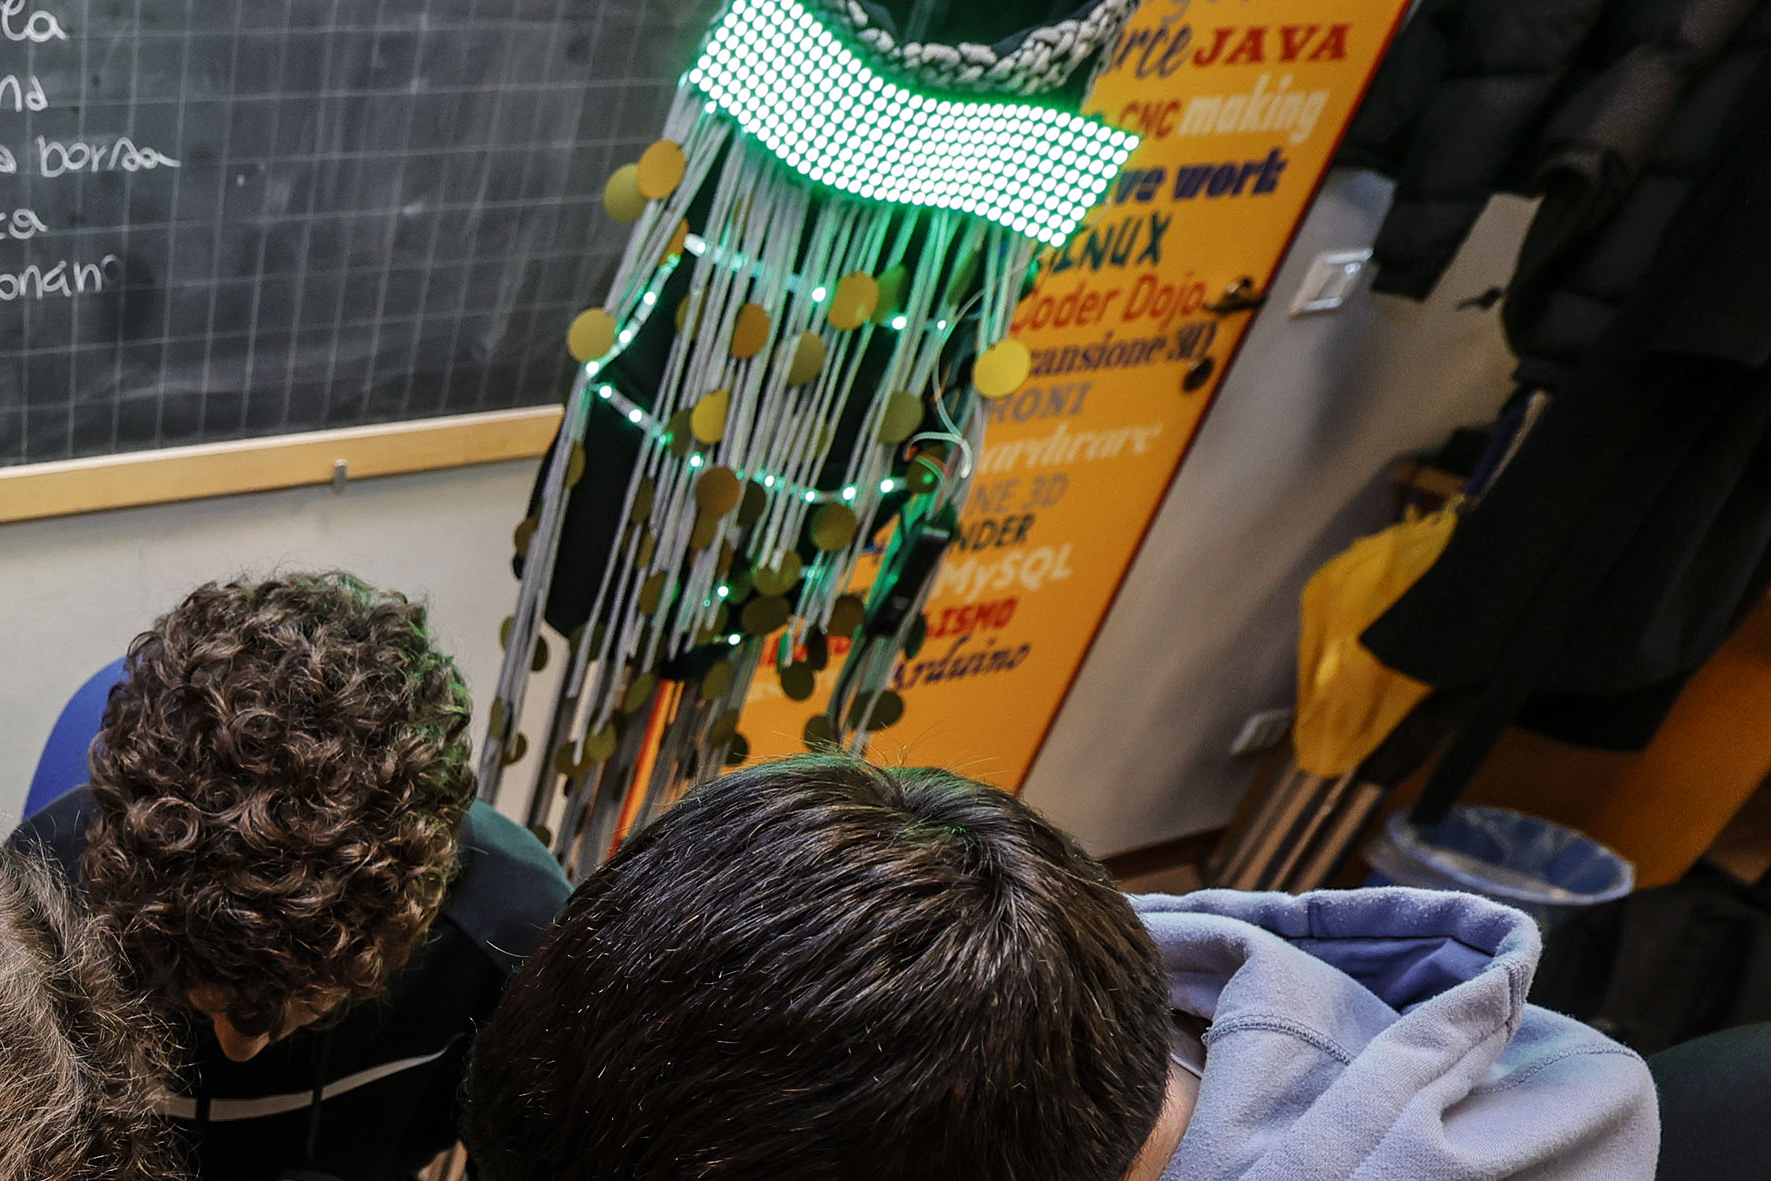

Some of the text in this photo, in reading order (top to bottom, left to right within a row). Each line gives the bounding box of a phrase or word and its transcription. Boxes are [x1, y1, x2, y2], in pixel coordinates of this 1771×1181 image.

[1108, 22, 1354, 80] rce JAVA
[1178, 72, 1330, 146] making
[36, 135, 182, 178] borsa
[1174, 147, 1290, 200] work
[1122, 270, 1208, 332] Dojo
[1031, 330, 1168, 377] ansione
[986, 380, 1094, 424] RONI
[930, 544, 1075, 604] MySQL
